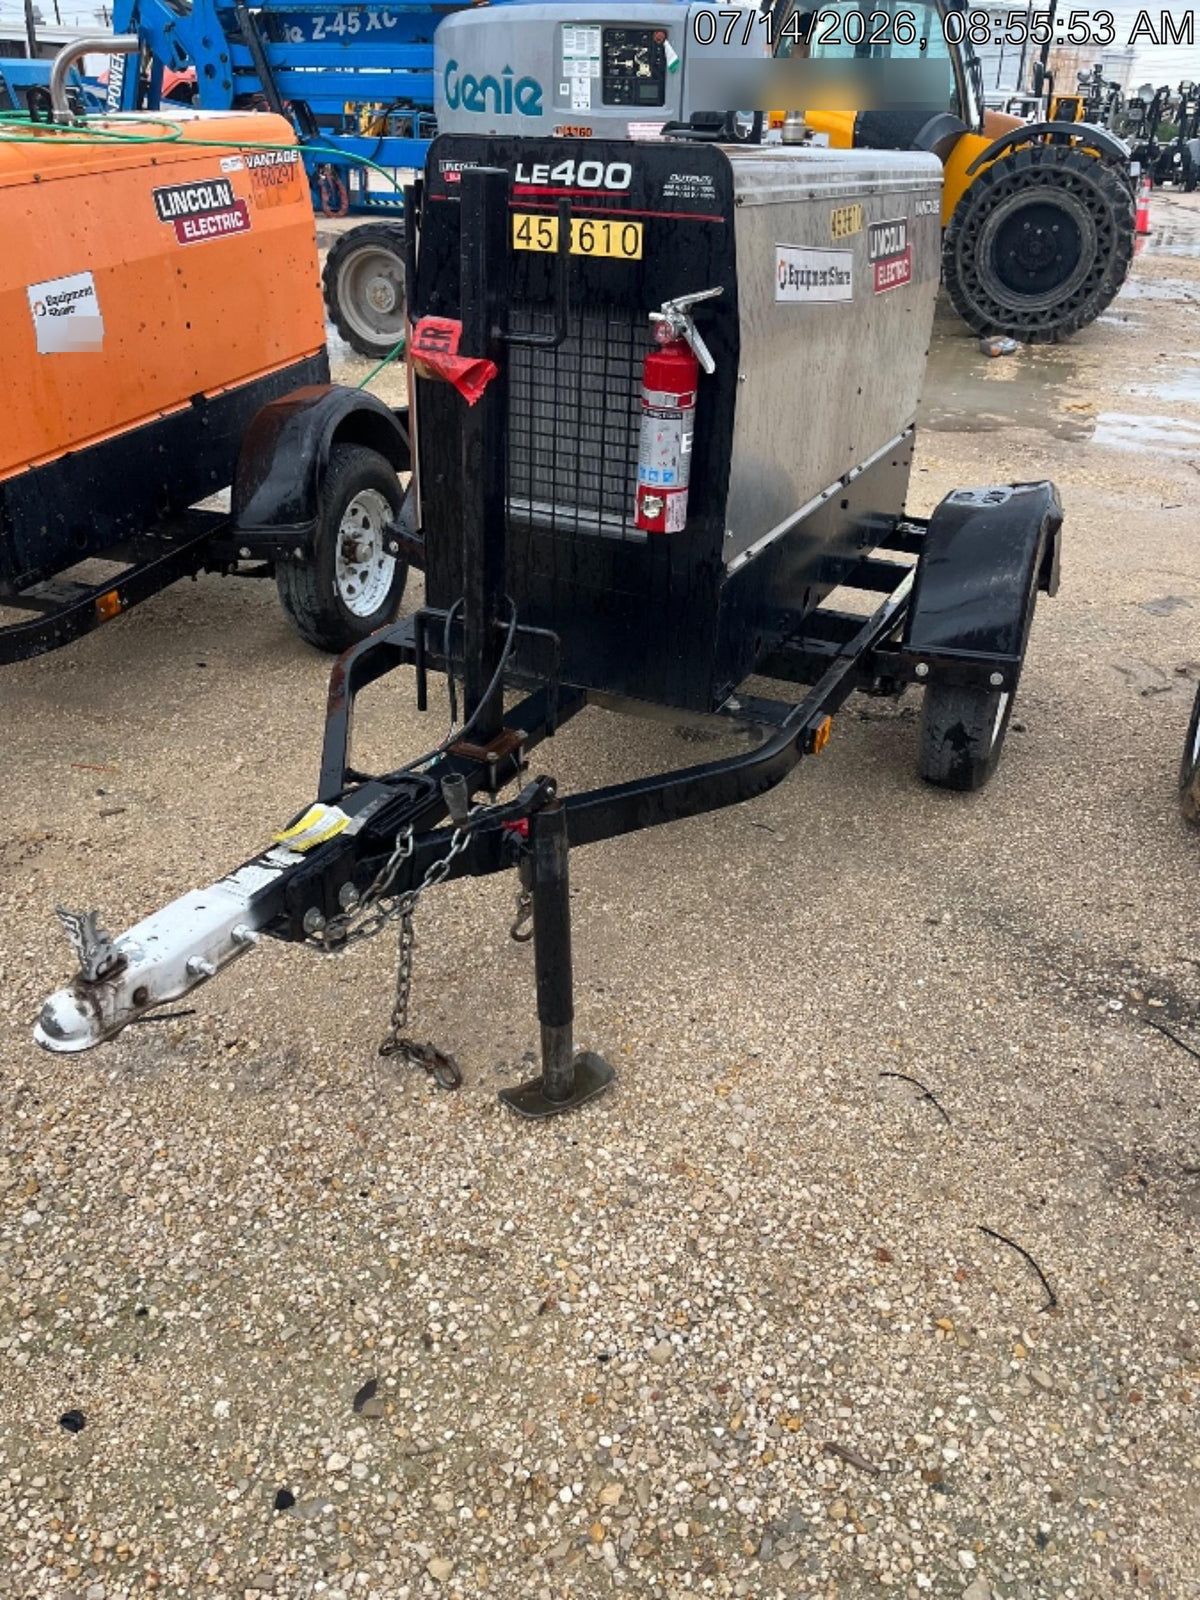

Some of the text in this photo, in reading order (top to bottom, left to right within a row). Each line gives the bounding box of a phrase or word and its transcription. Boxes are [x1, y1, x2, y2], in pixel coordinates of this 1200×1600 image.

[312, 12, 361, 40] Z-45
[445, 60, 543, 116] Genie
[245, 150, 298, 168] VANTAGE
[515, 160, 632, 189] LE400
[158, 184, 232, 217] LINCOLN
[183, 211, 244, 239] ELECTRIC
[516, 216, 639, 256] 45610
[788, 263, 851, 291] EquipmentShare
[46, 286, 94, 306] Equipment
